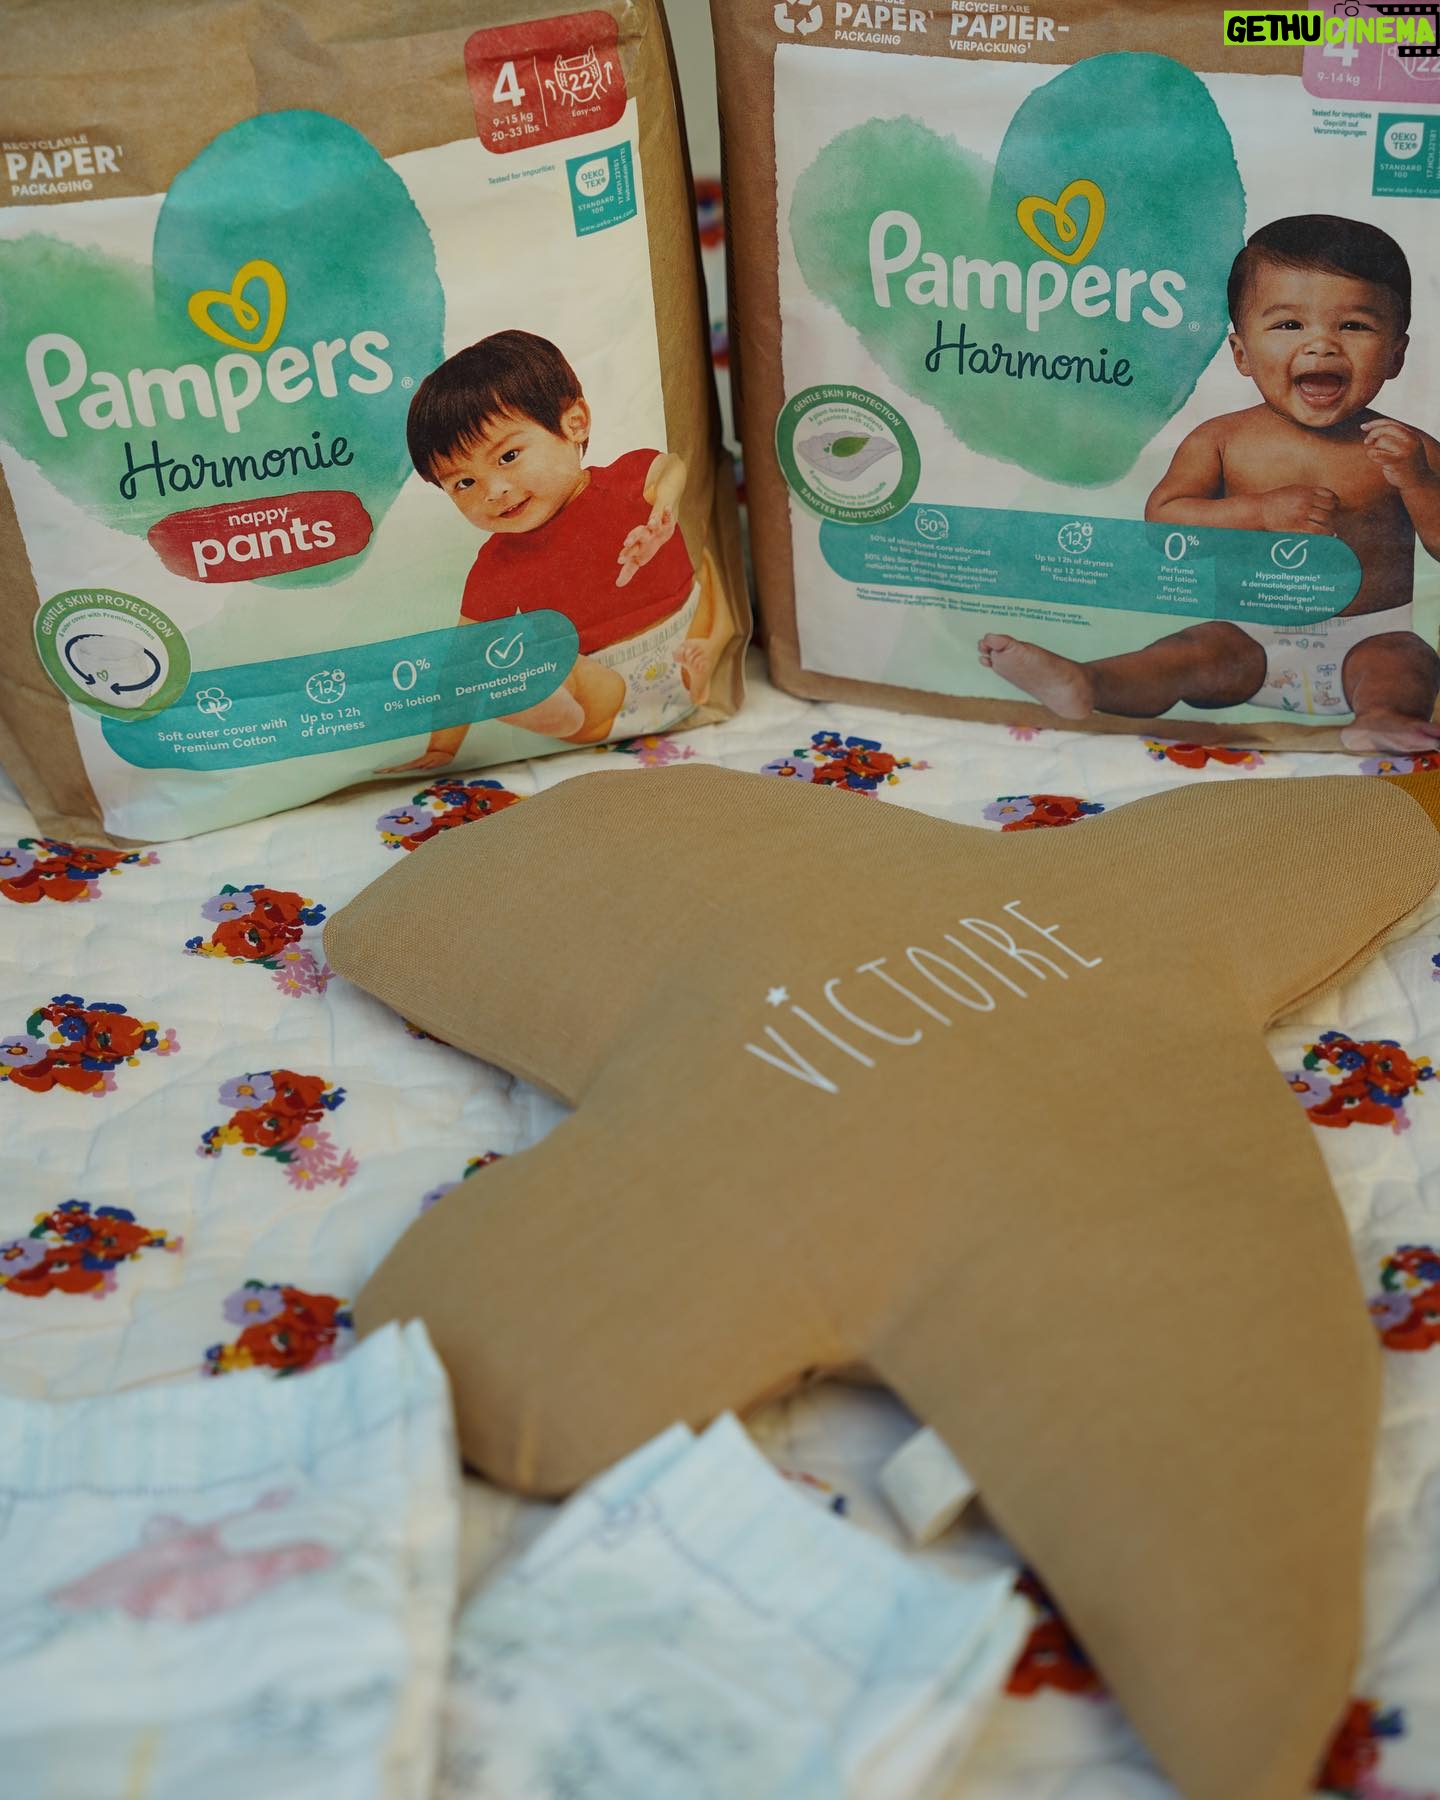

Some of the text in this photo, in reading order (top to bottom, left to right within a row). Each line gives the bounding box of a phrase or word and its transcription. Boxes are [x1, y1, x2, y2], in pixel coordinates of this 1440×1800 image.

[834, 30, 901, 45] PACKAGING
[492, 61, 526, 107] 4
[569, 70, 593, 92] 22
[1317, 72, 1360, 85] 9-14 kg
[492, 112, 534, 127] 9-15 kg
[571, 105, 601, 118] Easy-on
[1312, 109, 1372, 120] Tested for impurities
[492, 123, 540, 142] 20-33 lbs
[1391, 132, 1417, 141] OEKO
[512, 172, 521, 180] for
[581, 168, 604, 180] OEKO
[1380, 164, 1422, 172] STANDARD
[12, 179, 93, 197] PACKAGING
[868, 210, 1188, 332] Pampers
[924, 320, 1134, 387] Harmonie
[25, 330, 394, 438] Pampers
[794, 390, 901, 427] GENTLE SKIN PROTECTION
[119, 430, 355, 500] Harmonie
[800, 487, 838, 514] SANFTER
[838, 502, 896, 518] HAUTSCHUTZ
[228, 505, 289, 530] nappy
[920, 519, 946, 532] 50%
[191, 516, 337, 578] pants
[1066, 530, 1083, 546] 12
[1164, 532, 1200, 561] 0%
[1034, 554, 1046, 562] Up
[1058, 556, 1072, 564] 12h
[1074, 558, 1084, 566] of
[1083, 558, 1114, 568] dryness
[1158, 574, 1198, 584] and lotion
[1161, 566, 1194, 576] Perfume
[1248, 581, 1310, 592] dermatologically
[1312, 584, 1335, 592] tested
[42, 594, 174, 638] GENTLE SKIN PROTECTION
[392, 658, 431, 691] 0%
[456, 662, 557, 696] Dermatologically
[315, 680, 337, 694] 12
[490, 683, 527, 700] tested
[384, 694, 441, 712] 0% lotion
[300, 706, 361, 724] Up to 12h
[158, 718, 288, 742] Soft outer cover with
[301, 722, 366, 738] of dryness
[174, 734, 277, 753] Premium Cotton
[745, 900, 1102, 1094] VICTOIRE
